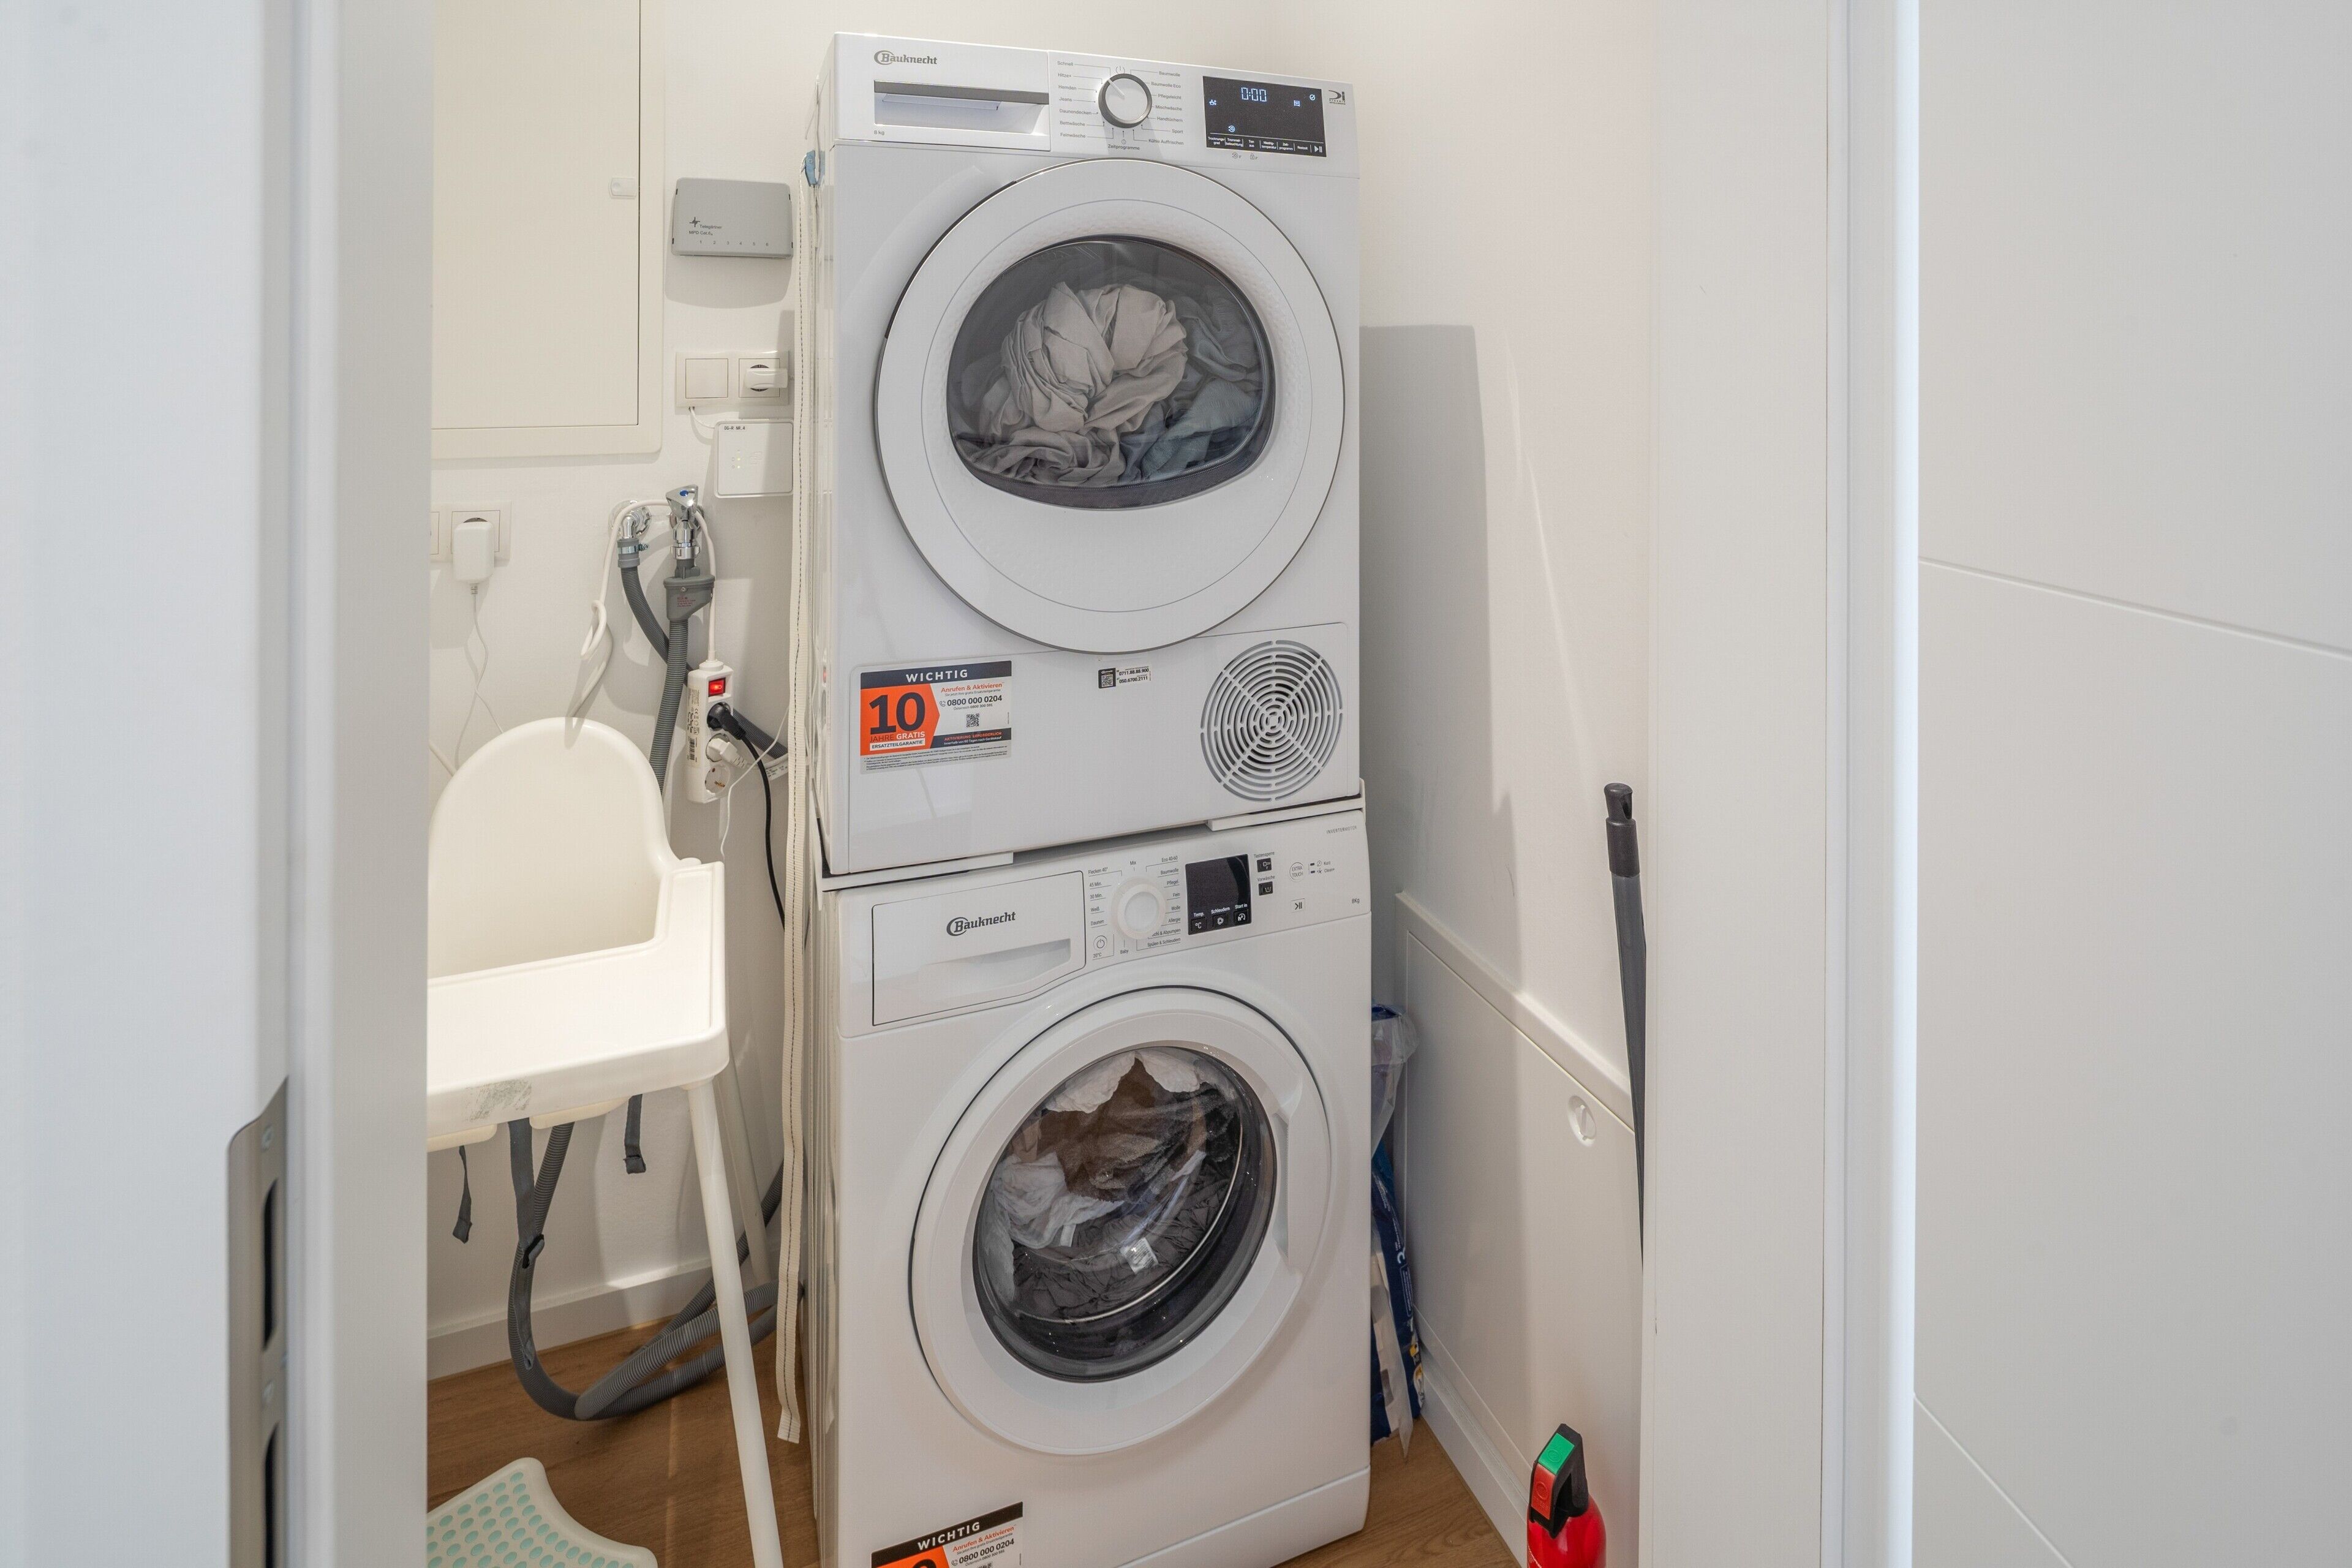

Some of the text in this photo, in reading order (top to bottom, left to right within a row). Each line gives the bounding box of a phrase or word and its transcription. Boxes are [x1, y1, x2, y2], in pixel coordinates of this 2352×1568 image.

[874, 50, 937, 65] Bauknecht
[1242, 87, 1267, 102] 0:00
[906, 669, 968, 683] WICHTIG
[869, 692, 925, 734] 10
[870, 731, 925, 742] JAHRE GRATIS
[872, 739, 924, 749] ERSATZTEILGARANTIE
[946, 911, 1016, 937] Bauknecht
[917, 1521, 981, 1551] WICHTIG
[953, 1540, 977, 1551] Anrufen
[959, 1538, 1014, 1564] 0800 000 0204
